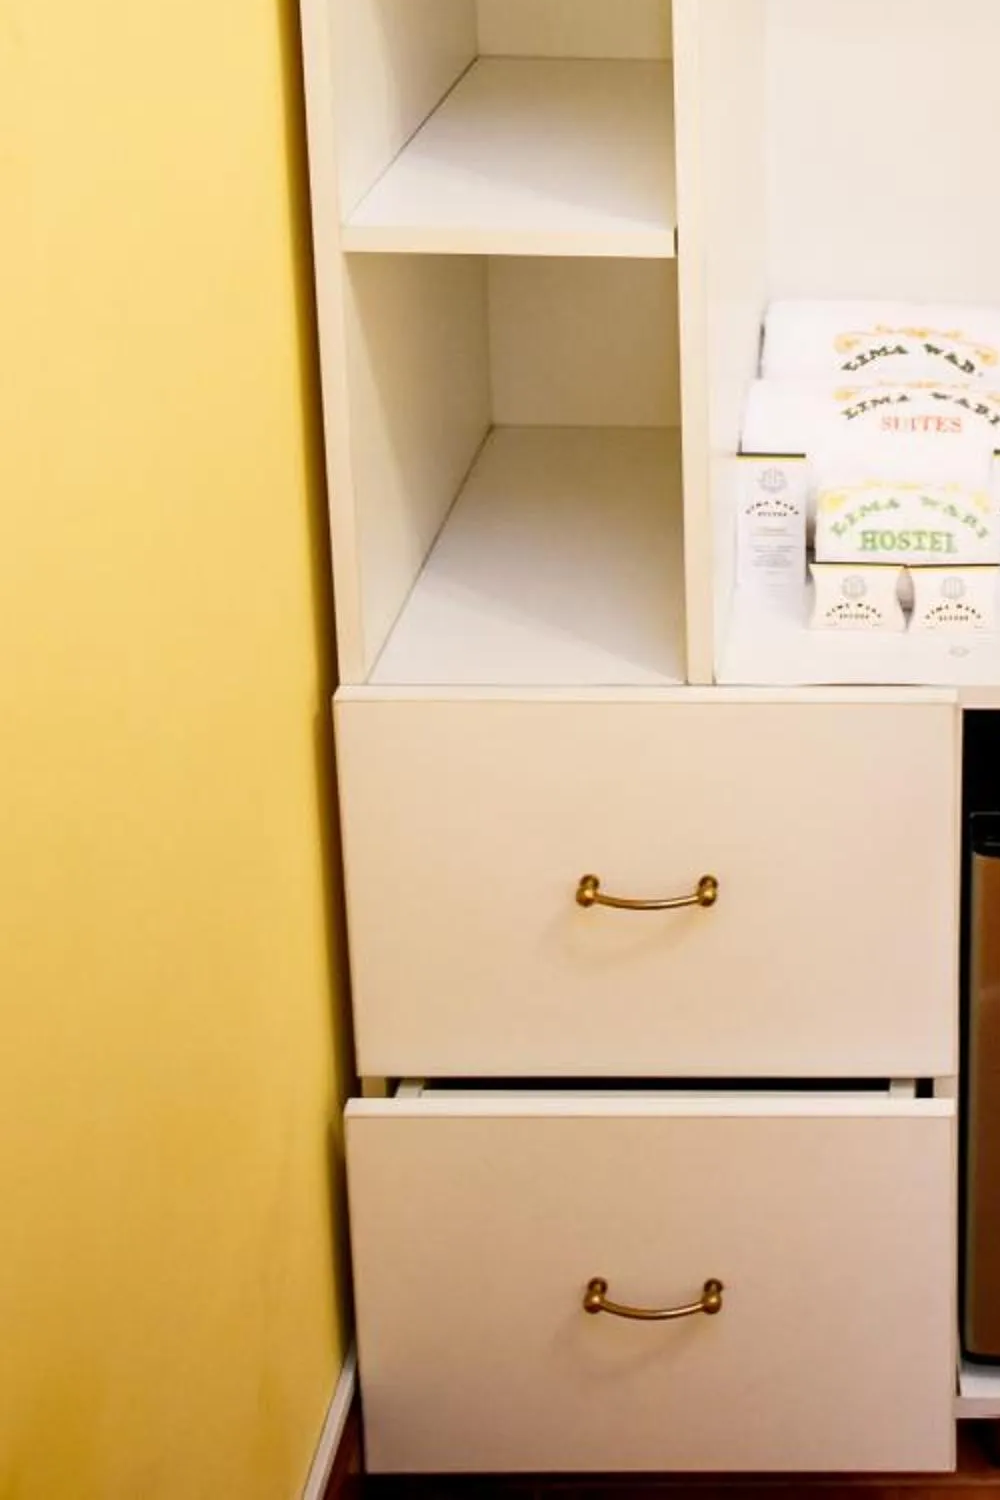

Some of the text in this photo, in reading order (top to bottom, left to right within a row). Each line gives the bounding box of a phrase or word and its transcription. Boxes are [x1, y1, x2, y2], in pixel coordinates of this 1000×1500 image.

[841, 344, 908, 371] LIMA
[841, 393, 910, 420] LIMA
[881, 414, 962, 433] SUITES
[831, 497, 900, 535] LIMA
[920, 495, 988, 538] WARI
[859, 529, 958, 553] HOSTEL
